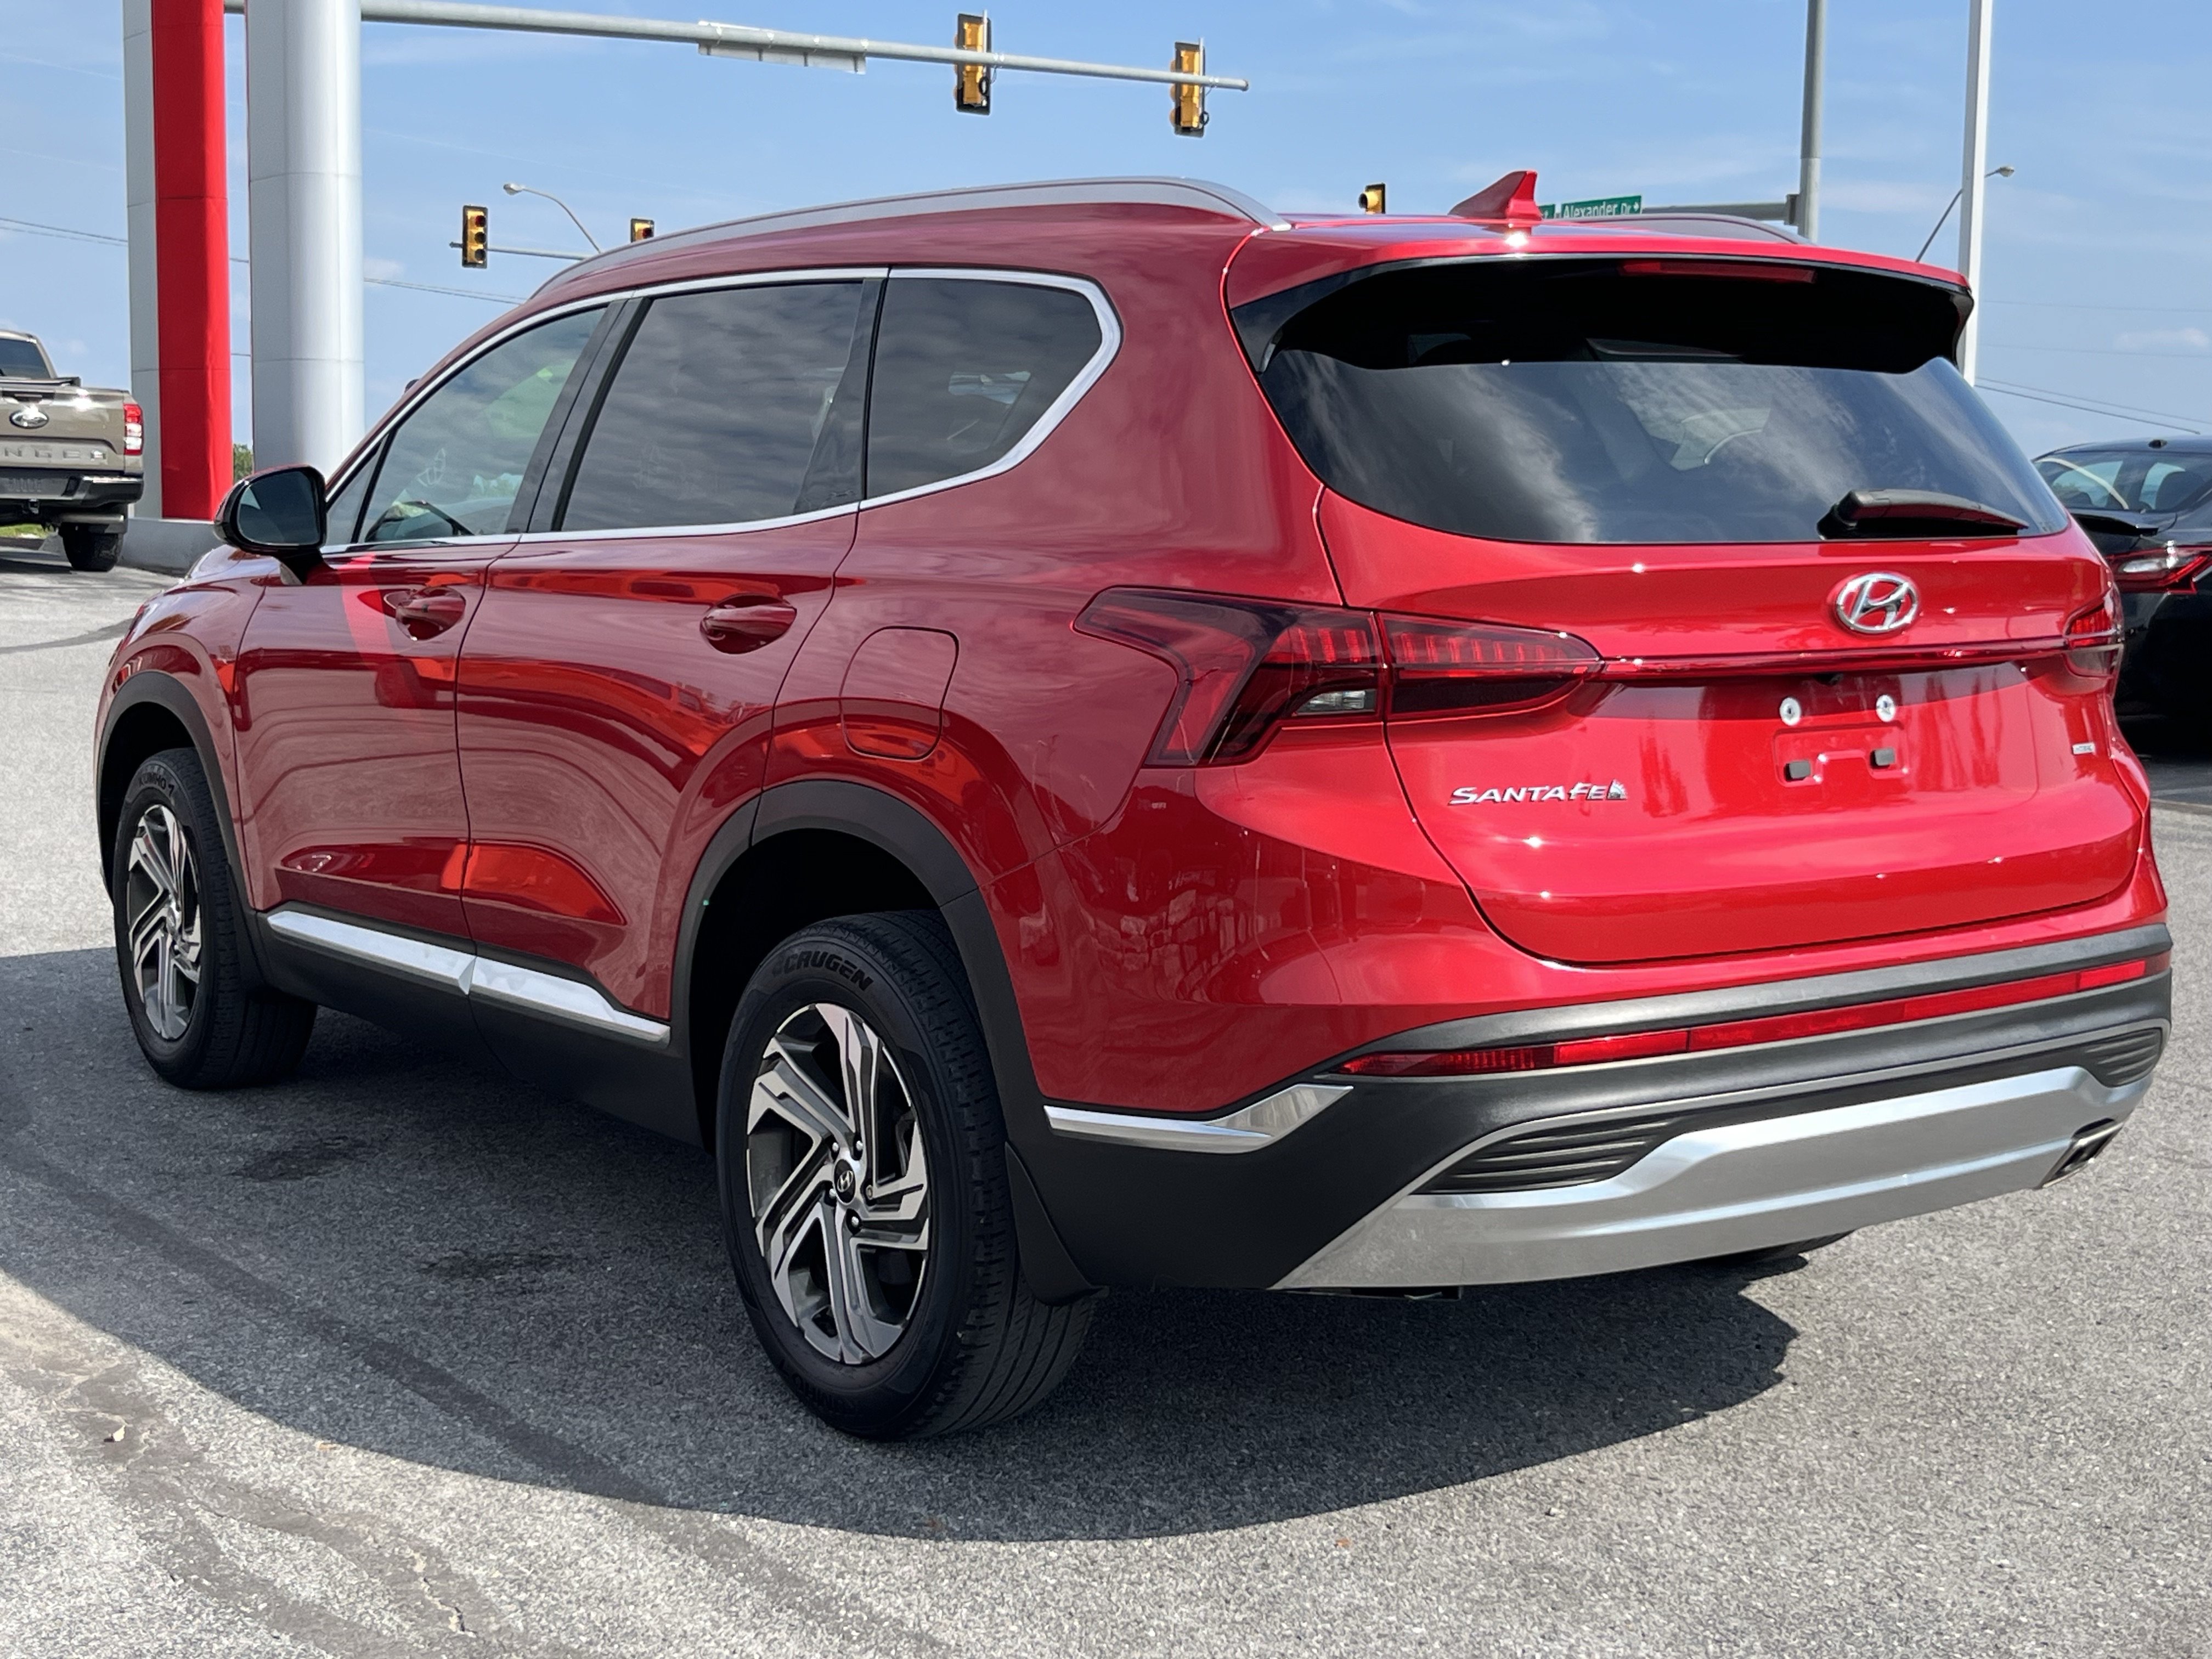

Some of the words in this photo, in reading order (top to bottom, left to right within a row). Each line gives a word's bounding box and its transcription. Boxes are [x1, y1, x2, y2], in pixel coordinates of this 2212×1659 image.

[1564, 201, 1617, 218] Alexander
[1621, 202, 1631, 215] Dr
[784, 951, 873, 991] CRUGEN
